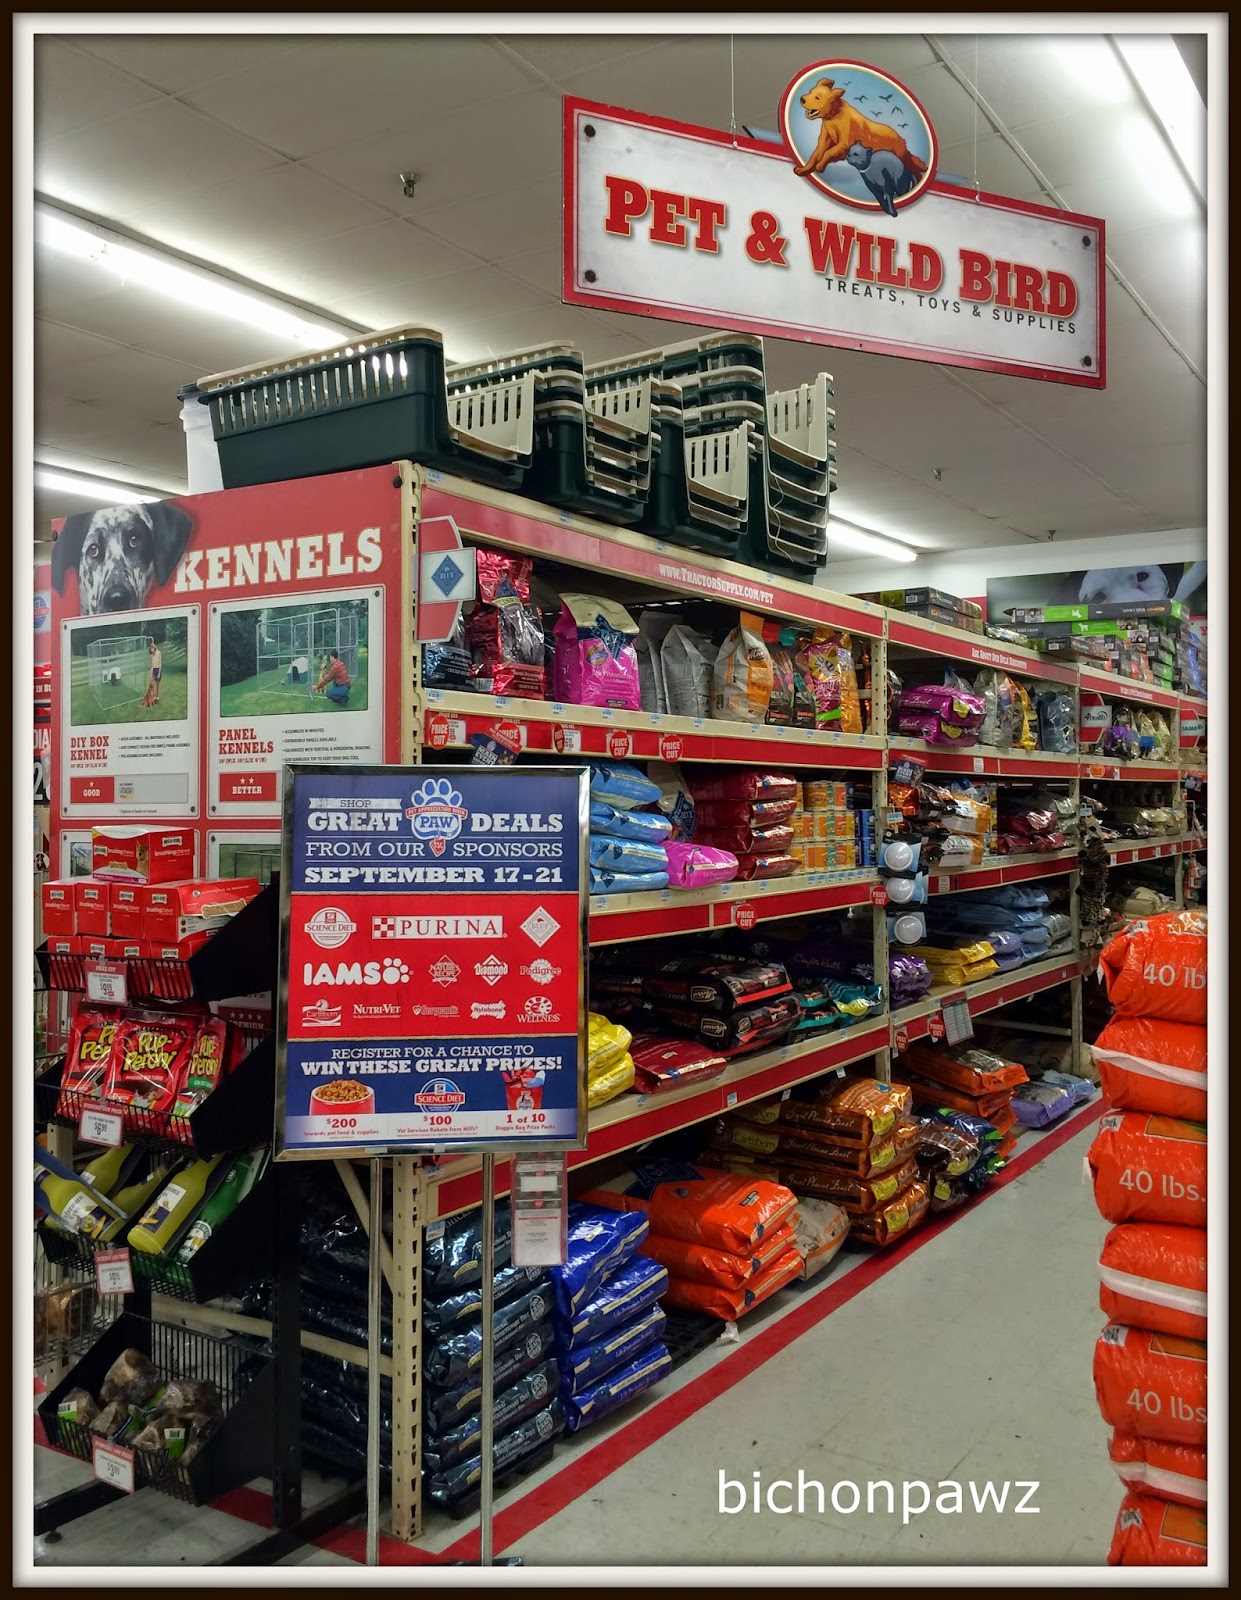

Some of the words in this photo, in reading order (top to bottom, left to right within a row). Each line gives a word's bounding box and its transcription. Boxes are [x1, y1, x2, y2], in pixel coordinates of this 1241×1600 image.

[604, 175, 726, 253] PET
[745, 210, 788, 266] &
[804, 216, 943, 294] WILD
[959, 247, 1078, 319] BIRD
[825, 277, 905, 304] TREATS,
[916, 294, 962, 313] TOYS
[972, 304, 981, 317] &
[992, 308, 1077, 335] SUPPLIES
[174, 528, 383, 593] KENNELS
[431, 723, 448, 734] PRICE
[219, 728, 257, 741] PANEL
[433, 735, 445, 745] CUT
[70, 737, 86, 748] DIY
[90, 736, 110, 747] BOX
[611, 737, 628, 747] PRICE
[663, 741, 680, 750] PRICE
[219, 741, 274, 755] KENNELS
[614, 747, 625, 756] CUT
[70, 749, 108, 761] KENNEL
[666, 750, 678, 759] CUT
[83, 789, 100, 797] GOOD
[232, 786, 262, 795] BETTER
[340, 800, 371, 808] SHOP
[307, 812, 402, 831] GREAT
[471, 813, 563, 832] DEALS
[420, 816, 454, 828] PAW
[306, 842, 372, 857] FROM
[378, 842, 425, 857] OUR
[453, 842, 563, 857] SPONSORS
[304, 867, 485, 883] SEPTEMBER
[494, 866, 563, 883] 17-21
[872, 890, 887, 899] PRICE
[737, 910, 755, 920] PRICE
[306, 924, 337, 932] SCIENCE
[338, 923, 354, 931] DIET
[400, 919, 498, 935] PURINA
[740, 919, 753, 928] CUT
[304, 961, 381, 986] IAMS
[474, 963, 508, 976] Diamond
[520, 966, 562, 976] Pedigree
[1143, 963, 1175, 987] 40
[517, 1013, 561, 1023] WELLNESS
[930, 1023, 944, 1031] PRICE
[932, 1029, 943, 1037] CUT
[331, 1048, 401, 1059] REGISTER
[404, 1047, 434, 1058] FOR
[436, 1047, 448, 1057] A
[450, 1045, 512, 1057] CHANCE
[514, 1045, 534, 1055] TO
[124, 1052, 177, 1072] Peroni
[190, 1053, 219, 1075] Peroni
[301, 1061, 344, 1076] WIN
[347, 1060, 411, 1075] THESE
[415, 1058, 482, 1073] GREAT
[486, 1056, 562, 1072] PRIZES!
[417, 1095, 446, 1103] SCIENCE
[447, 1094, 462, 1102] DIET
[326, 1118, 357, 1128] $200
[424, 1115, 452, 1126] $100
[507, 1114, 513, 1123] 1
[532, 1113, 546, 1123] 10
[1119, 1169, 1153, 1193] 40
[1162, 1175, 1207, 1202] lbs.
[1127, 1388, 1161, 1415] 40
